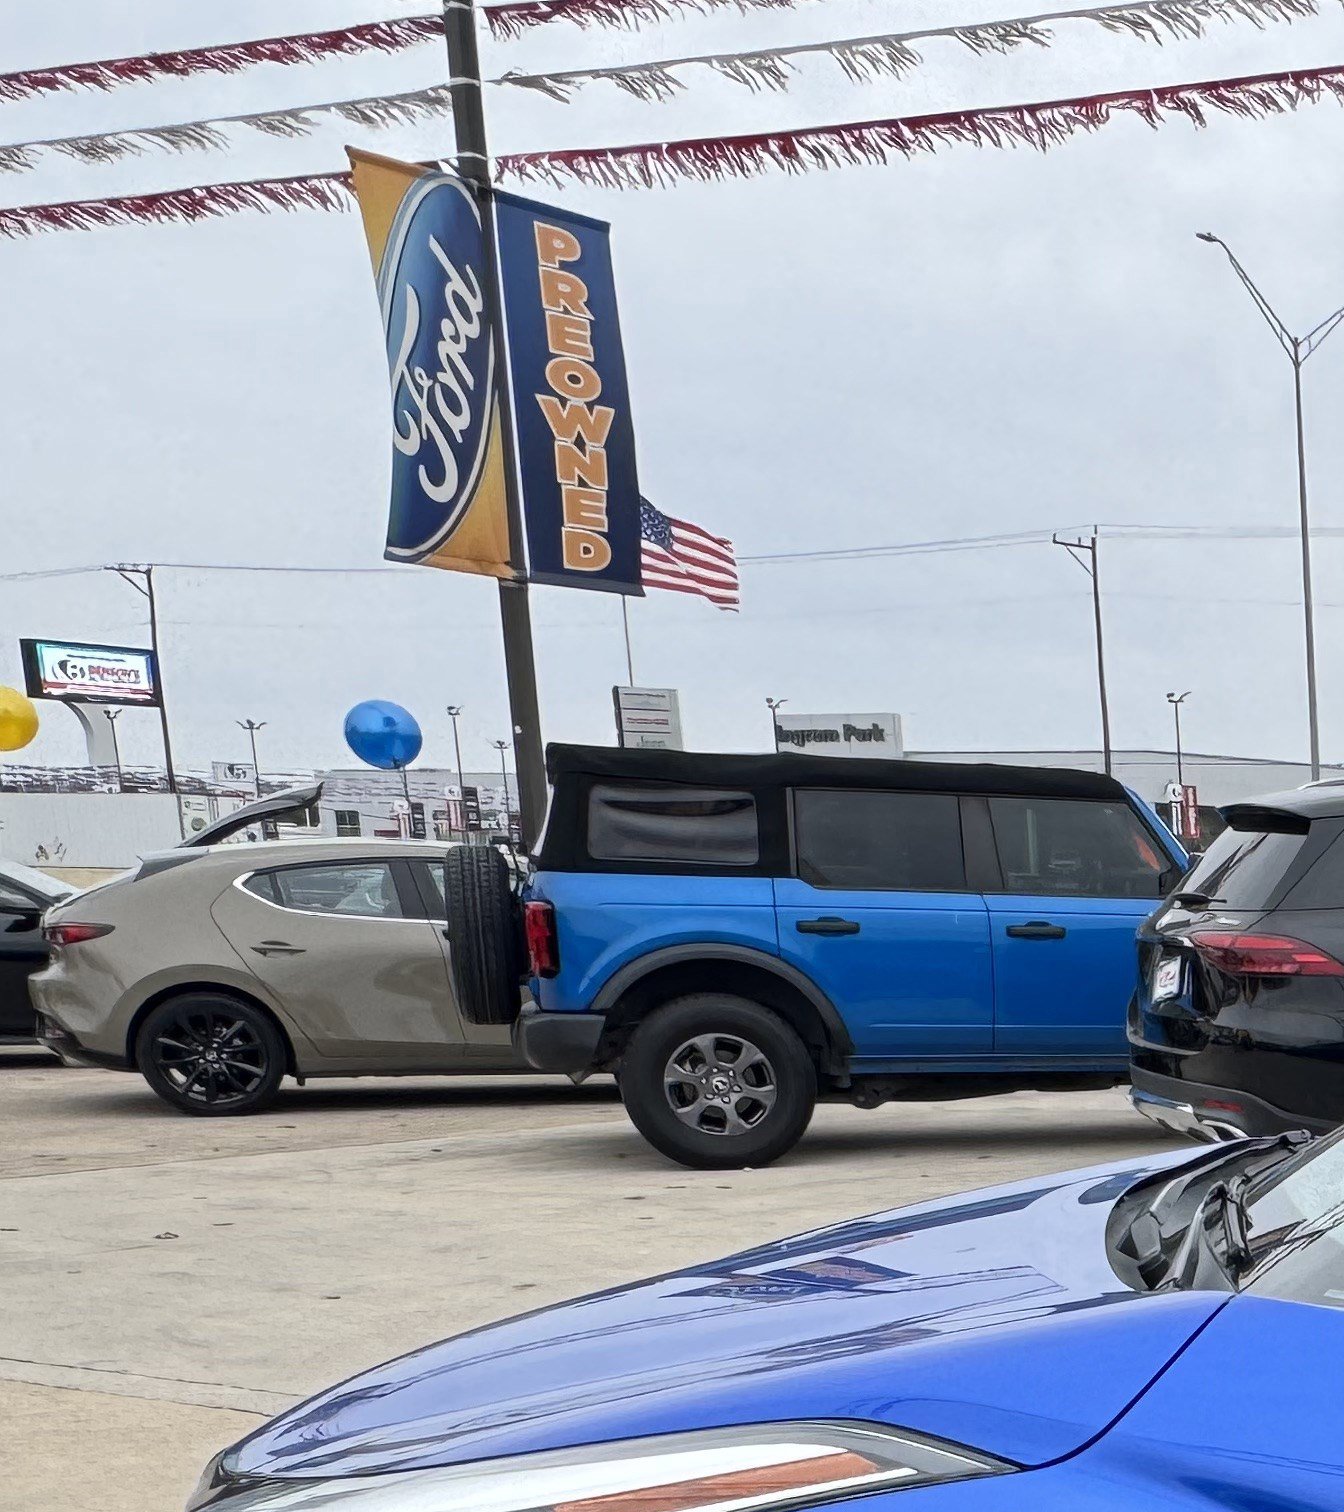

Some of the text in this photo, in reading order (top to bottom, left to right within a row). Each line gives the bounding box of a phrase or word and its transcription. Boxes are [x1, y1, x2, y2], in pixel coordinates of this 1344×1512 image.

[392, 233, 484, 503] Ford
[533, 220, 615, 572] PREOWNED
[843, 723, 885, 742] Park
